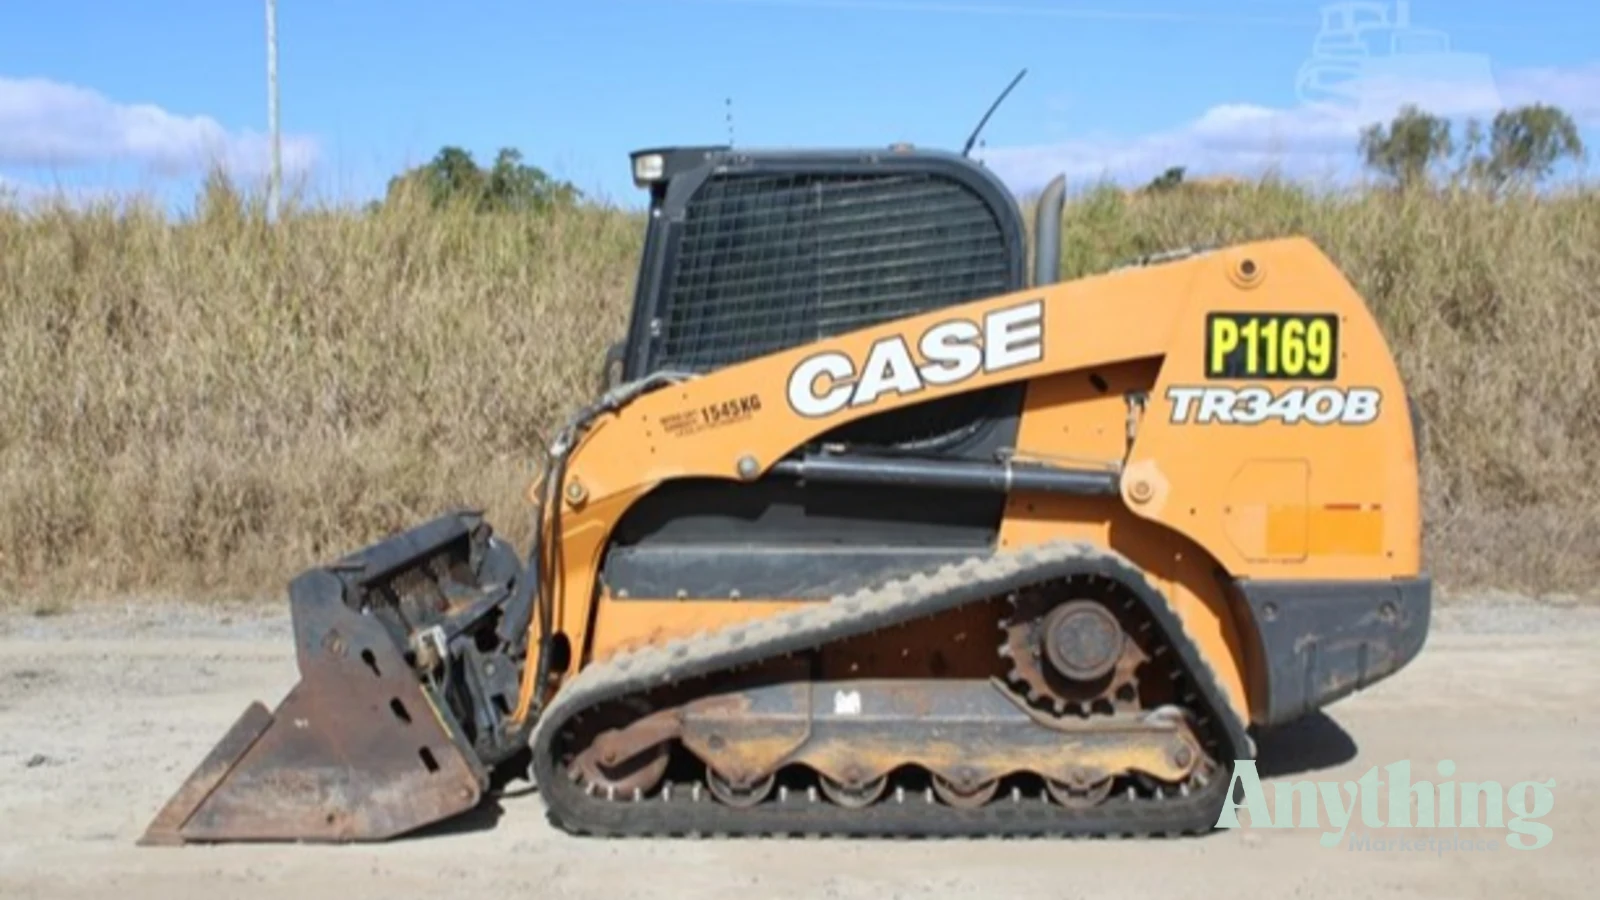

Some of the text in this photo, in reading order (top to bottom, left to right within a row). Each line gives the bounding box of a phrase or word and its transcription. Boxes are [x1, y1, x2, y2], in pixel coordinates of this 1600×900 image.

[787, 299, 1044, 417] CASE
[1211, 317, 1332, 375] P1169
[1166, 385, 1382, 424] TR340B
